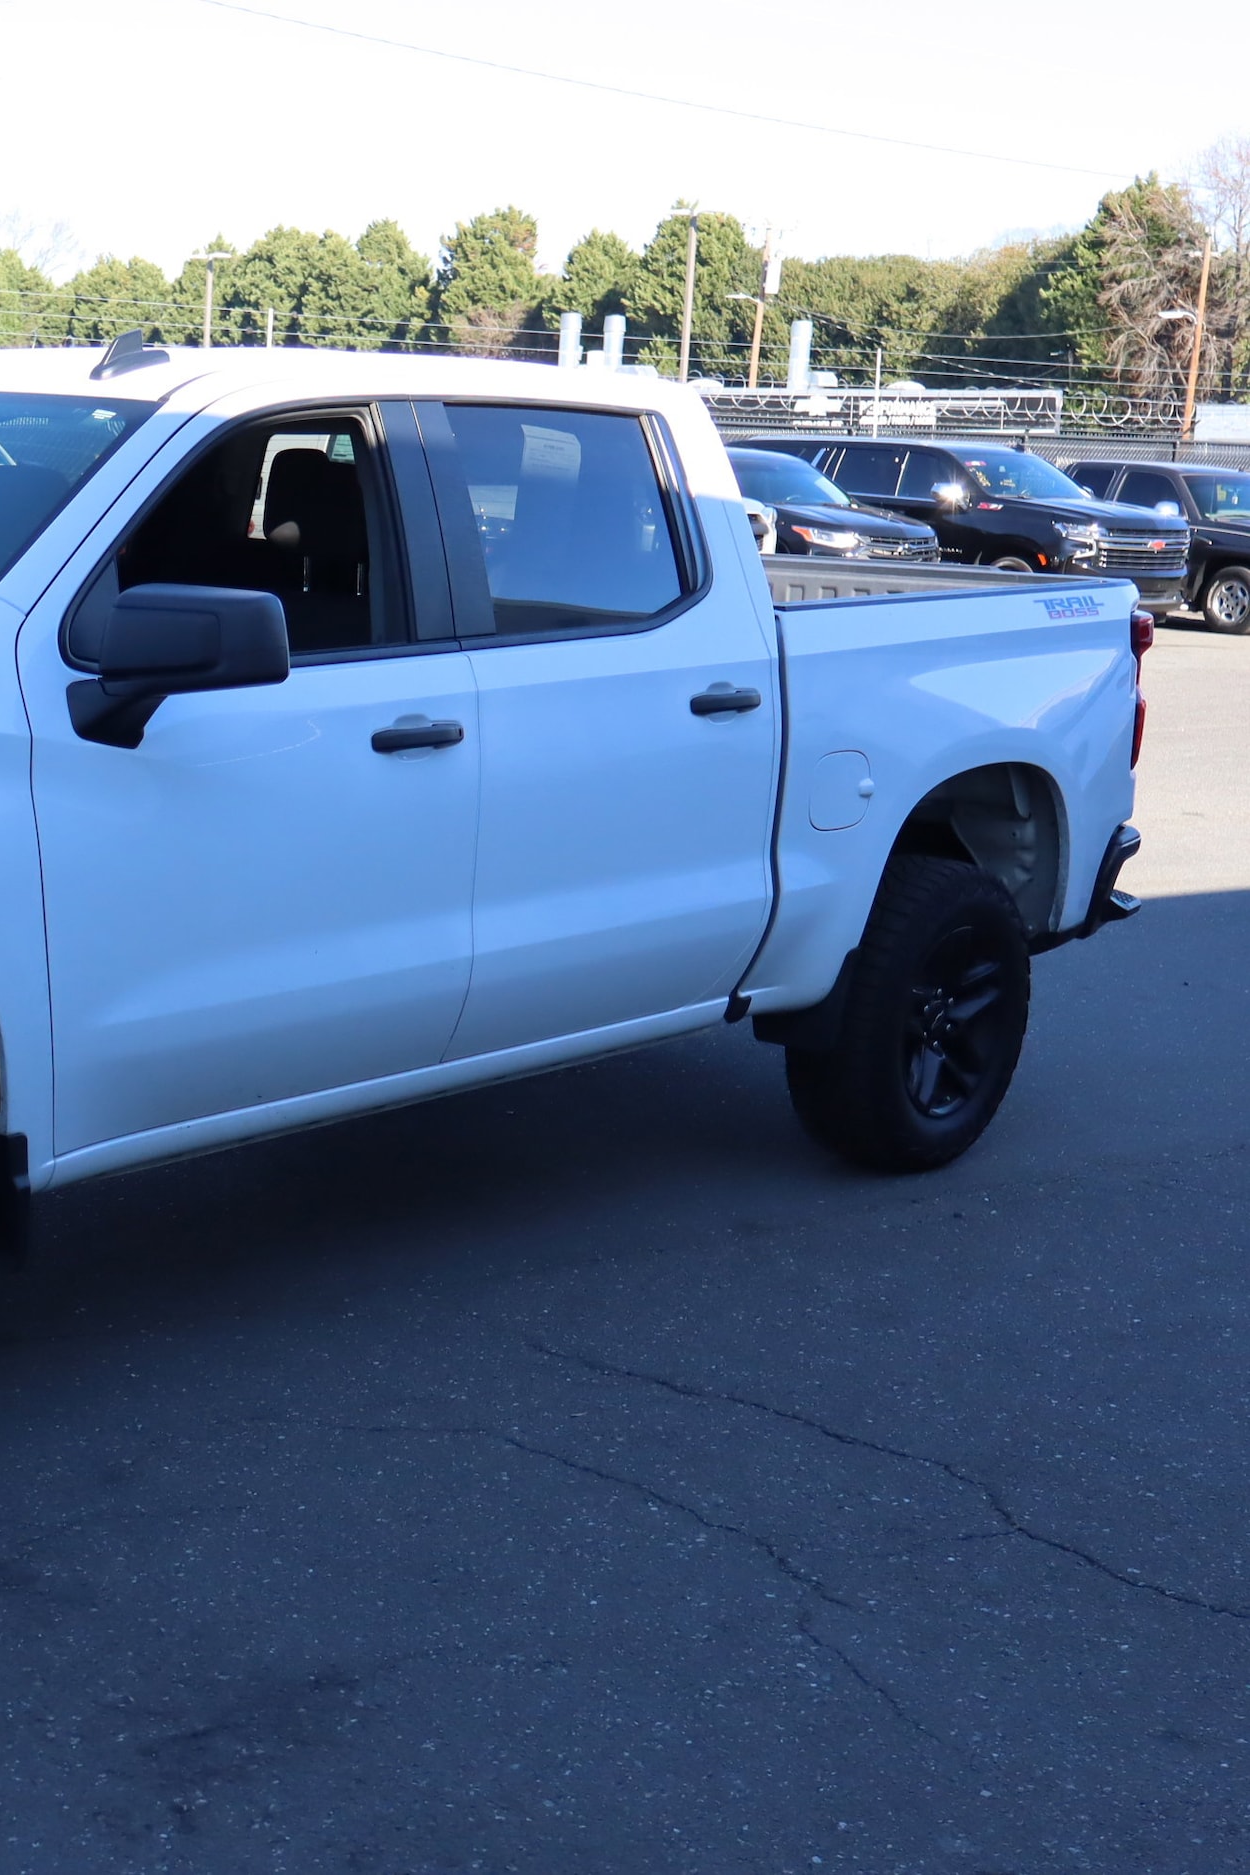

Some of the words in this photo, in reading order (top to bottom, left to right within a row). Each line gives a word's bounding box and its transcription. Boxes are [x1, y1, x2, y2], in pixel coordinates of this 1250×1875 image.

[859, 400, 937, 416] PEFORMANCE
[1034, 595, 1104, 610] TRAIL
[1048, 607, 1100, 619] BOSS
